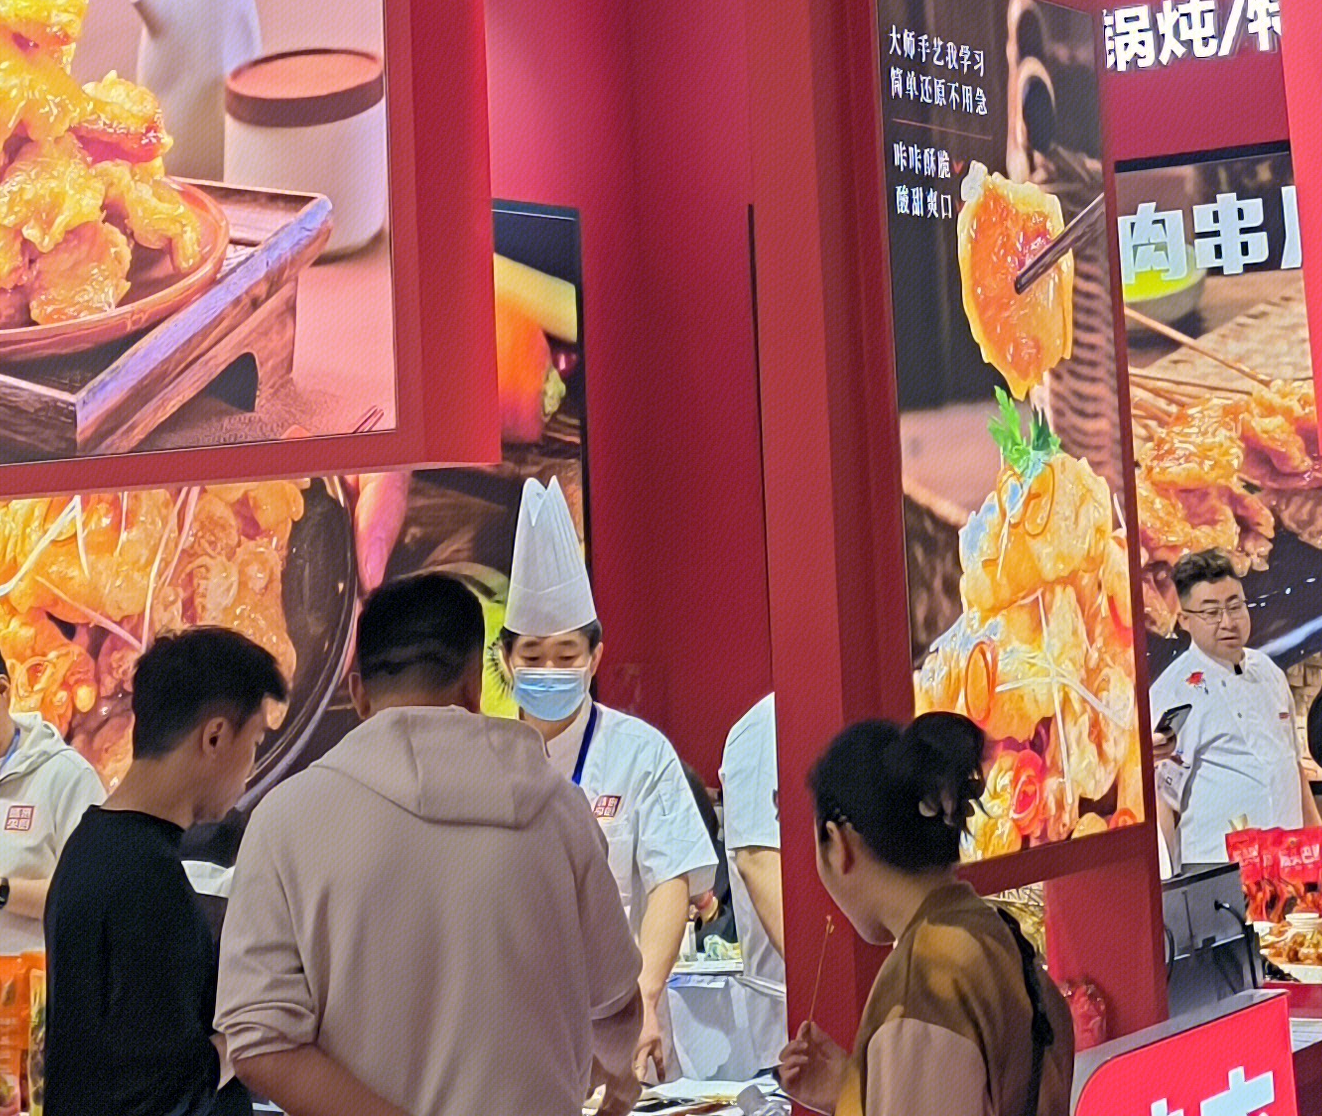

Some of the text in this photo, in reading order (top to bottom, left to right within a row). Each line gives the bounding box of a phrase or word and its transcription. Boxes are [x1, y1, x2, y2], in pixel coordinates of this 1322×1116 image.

[888, 23, 986, 78] 大师手艺我学习
[890, 64, 989, 116] 简单还原不用急
[893, 140, 952, 180] 咔咔酥脆
[895, 184, 953, 221] 酸甜爽口
